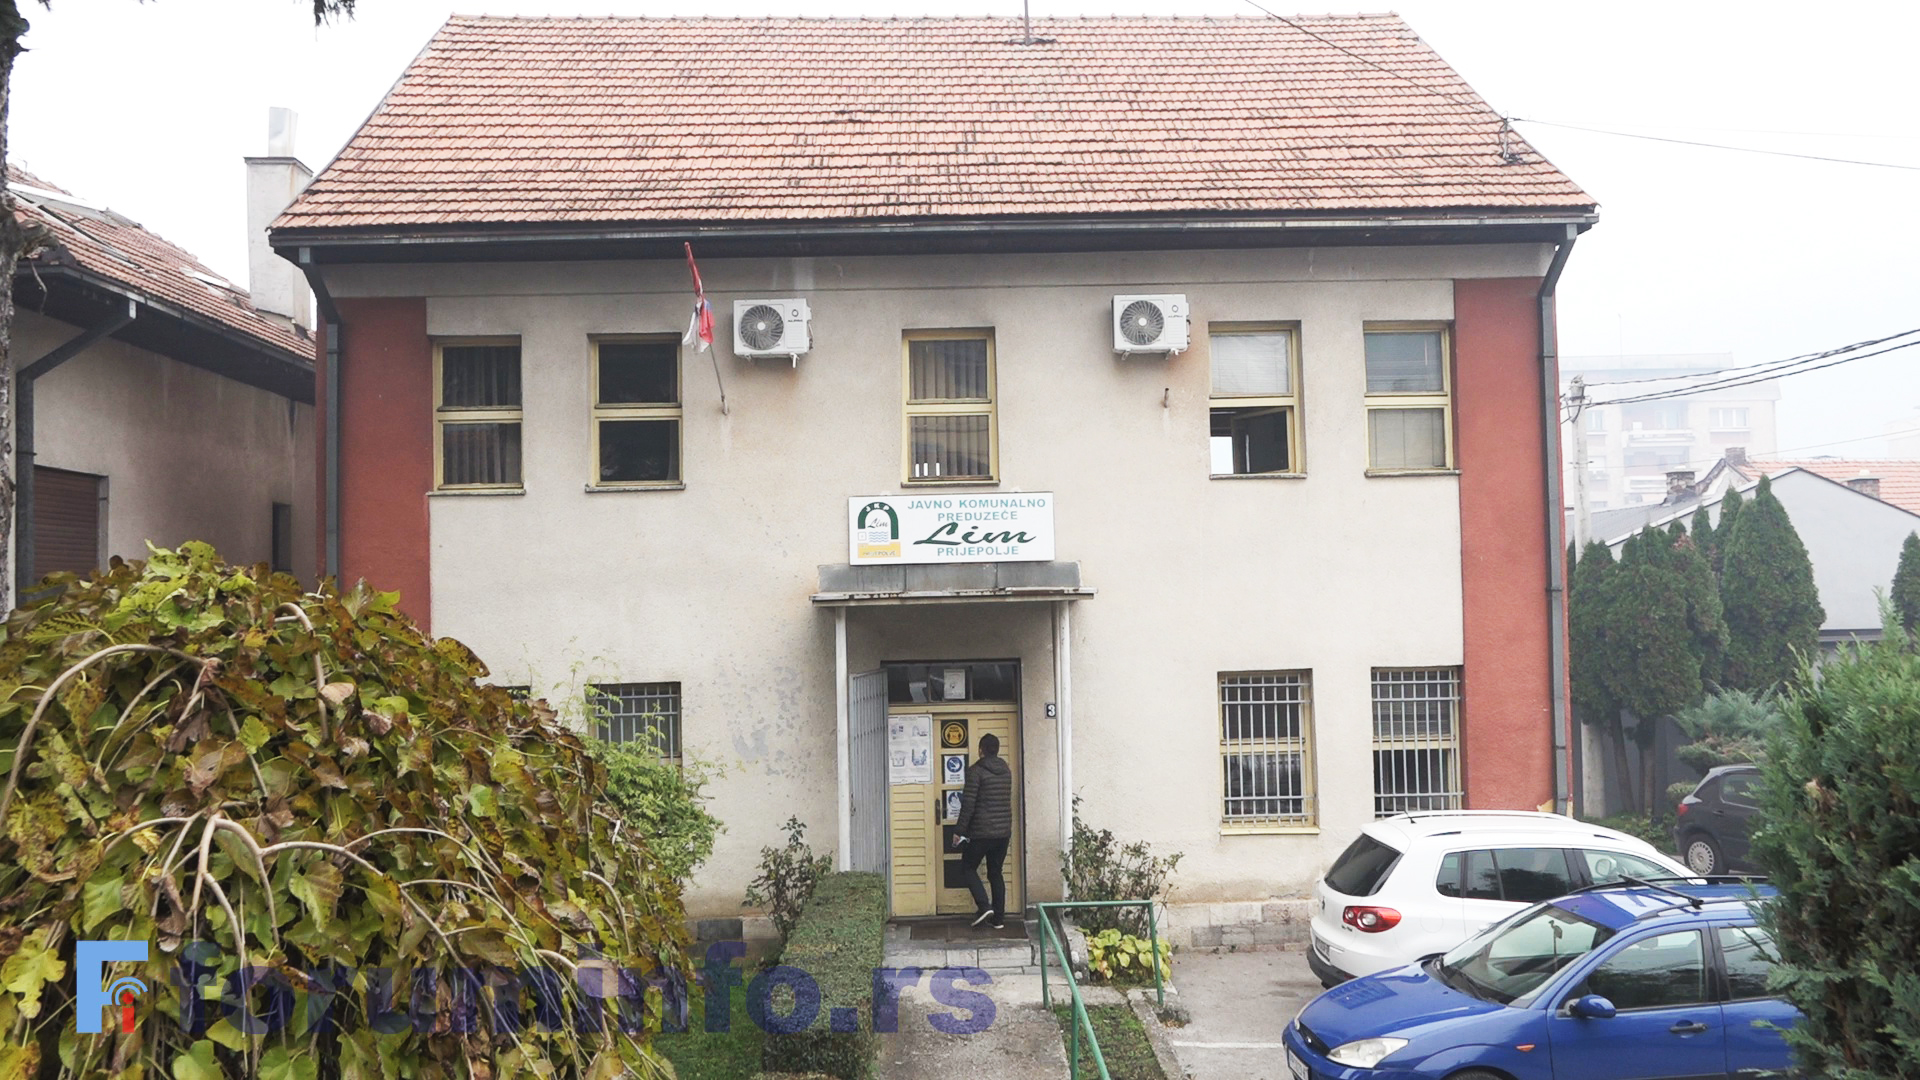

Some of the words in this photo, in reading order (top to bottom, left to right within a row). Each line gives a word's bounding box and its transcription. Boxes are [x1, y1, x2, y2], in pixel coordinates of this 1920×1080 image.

[865, 502, 890, 512] JKP
[908, 500, 952, 509] JAVNO
[959, 498, 1046, 509] KOMUNALNO
[937, 510, 1018, 522] PREDUZEĆE
[913, 522, 1036, 545] Lim
[937, 545, 1019, 557] PRIJEPOLJE
[1048, 704, 1056, 716] 3
